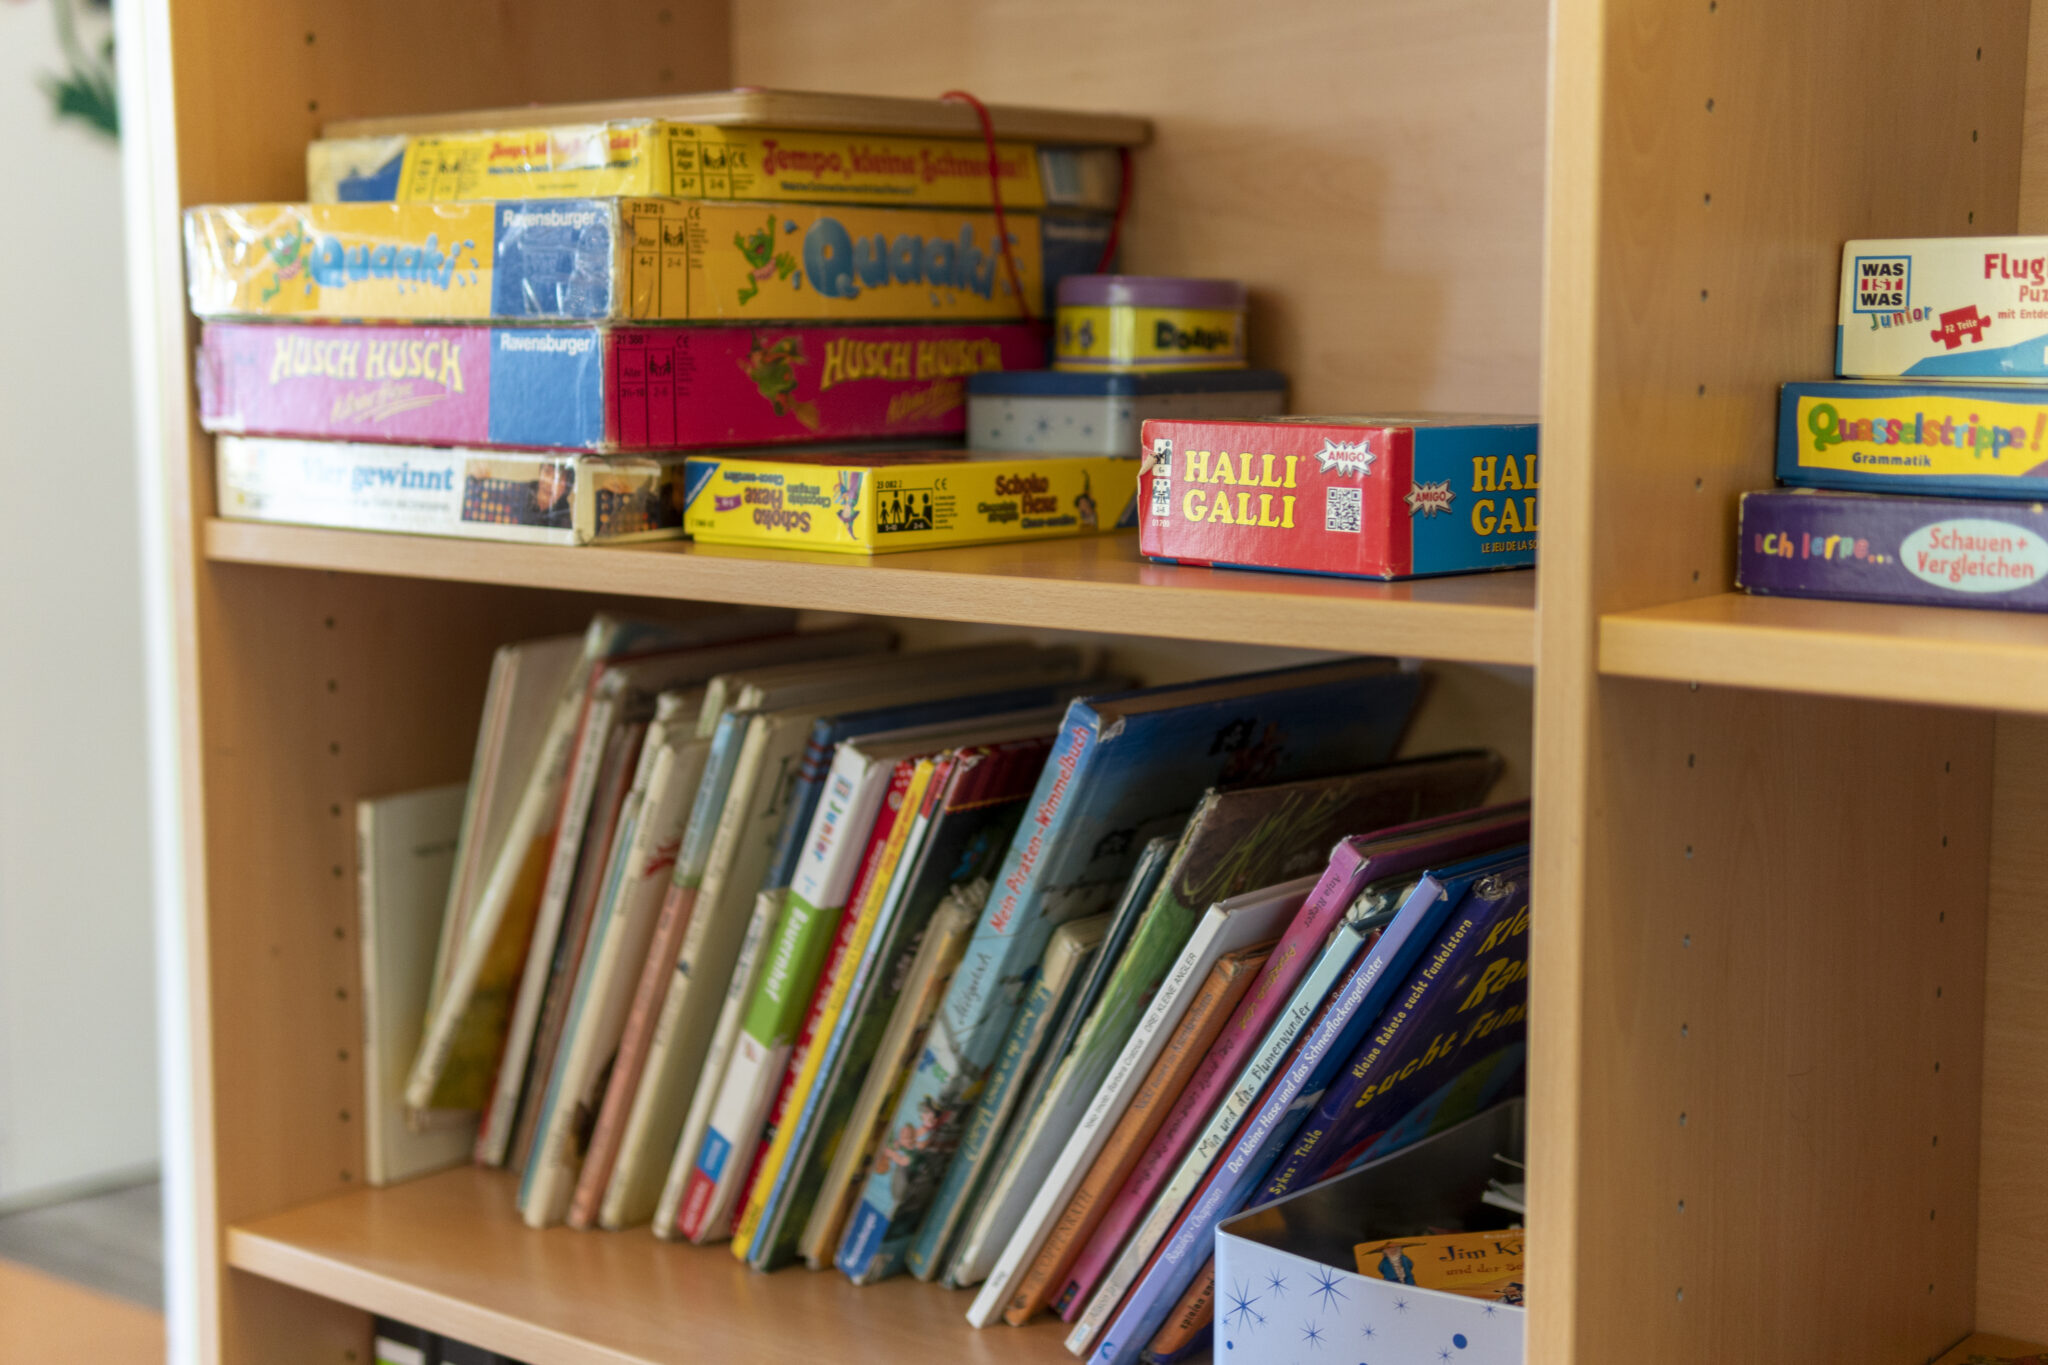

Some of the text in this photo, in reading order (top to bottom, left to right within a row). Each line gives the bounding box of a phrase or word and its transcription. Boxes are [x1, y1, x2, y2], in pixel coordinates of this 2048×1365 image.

[1862, 263, 1904, 277] WAS
[1861, 278, 1904, 291] IST
[1861, 293, 1903, 306] WAS
[1871, 305, 1932, 331] Junior
[1957, 319, 1978, 332] Teile
[1998, 309, 2016, 320] mit
[501, 332, 591, 356] Ravensburger
[271, 334, 465, 393] HUSCH HUSCH
[820, 337, 912, 392] HUSCH
[1808, 403, 2048, 459] Quasselstrippe!
[1184, 449, 1299, 489] HALLI
[1328, 451, 1365, 462] AMIGO
[1852, 452, 1932, 468] Grammatik
[352, 462, 454, 492] gewinnt
[1182, 489, 1297, 529] GALLI
[1415, 491, 1446, 502] AMIGO
[753, 508, 811, 532] Schoko
[1481, 543, 1490, 553] LE
[1492, 542, 1505, 552] JEU
[1507, 541, 1516, 551] DE
[1517, 540, 1527, 550] LA
[1754, 532, 1794, 559] Ich
[1929, 527, 2013, 554] Schauen
[1917, 550, 2035, 583] Vergleichen
[989, 894, 1018, 934] Mein
[1006, 726, 1090, 895] Piraten-Wimmelbuch
[1321, 872, 1343, 898] Anja
[765, 906, 809, 1002] Bauernhof
[1143, 951, 1197, 1033] DREI KLEINE ANGLER
[1401, 977, 1429, 1010] sucht
[1226, 955, 1384, 1173] Der kleine Hase und das Schneeflockengeflüster
[1355, 1032, 1458, 1109] sucht
[1195, 997, 1313, 1159] Mia und das Blumenwunder
[1439, 1246, 1486, 1261] Jim
[1446, 1265, 1472, 1276] und
[1477, 1264, 1499, 1273] der
